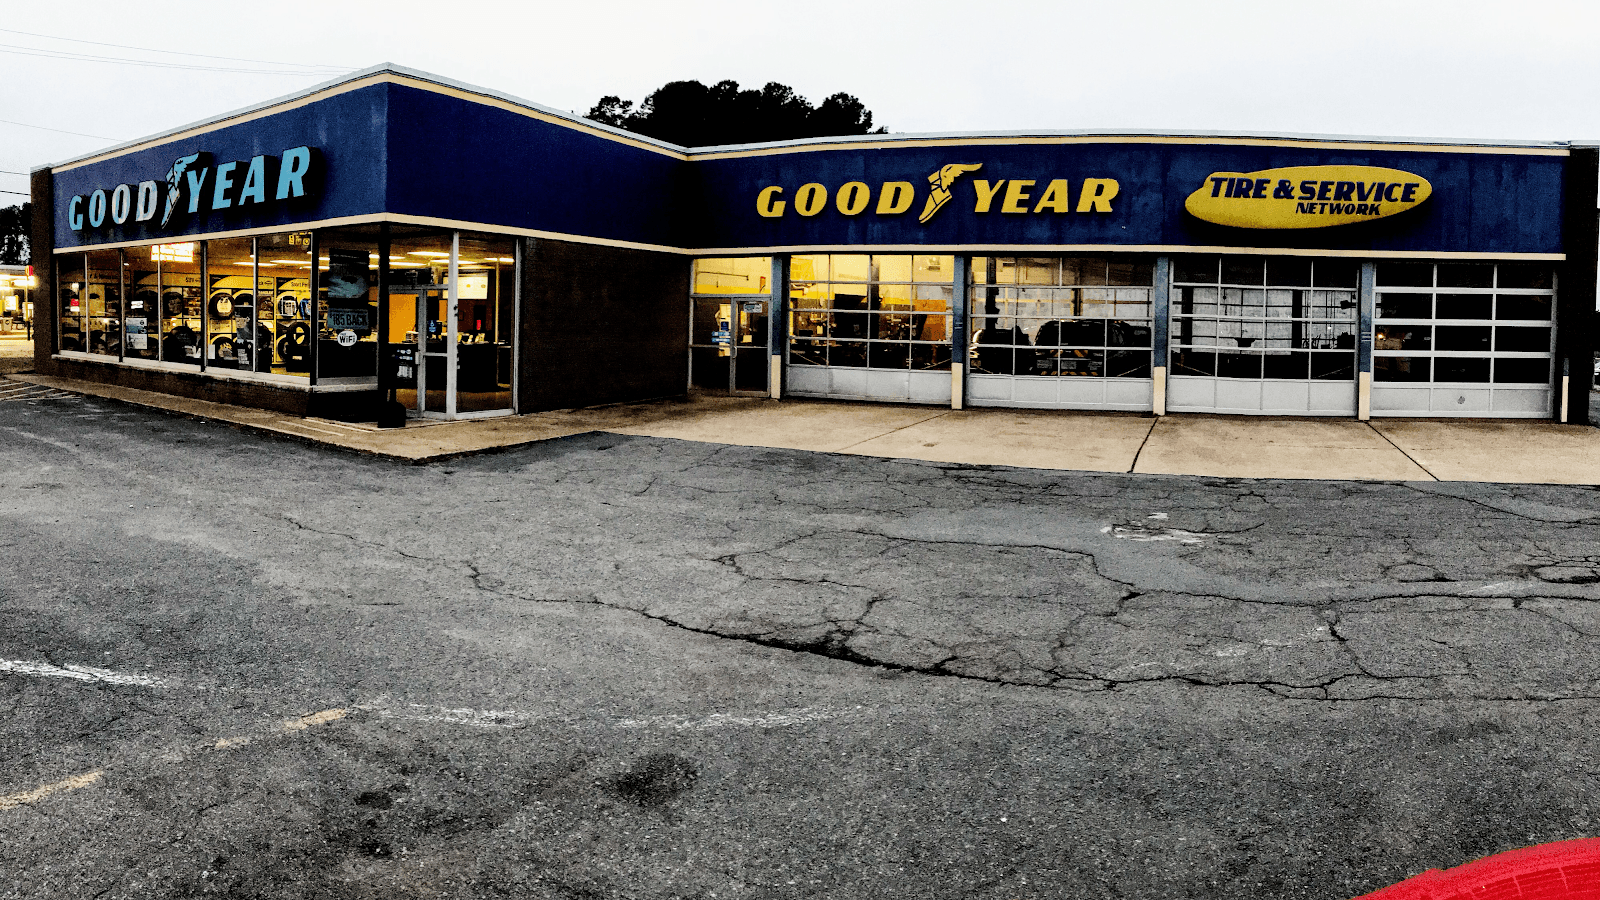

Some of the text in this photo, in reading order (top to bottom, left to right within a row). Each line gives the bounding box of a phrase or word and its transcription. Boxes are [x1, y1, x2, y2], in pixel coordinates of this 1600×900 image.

[68, 145, 311, 231] GOOD YEAR
[756, 177, 1120, 218] GOOD YEAR
[1210, 176, 1420, 203] TIRE & SERVICE
[1295, 202, 1381, 216] NETWORK
[346, 314, 368, 326] BACK
